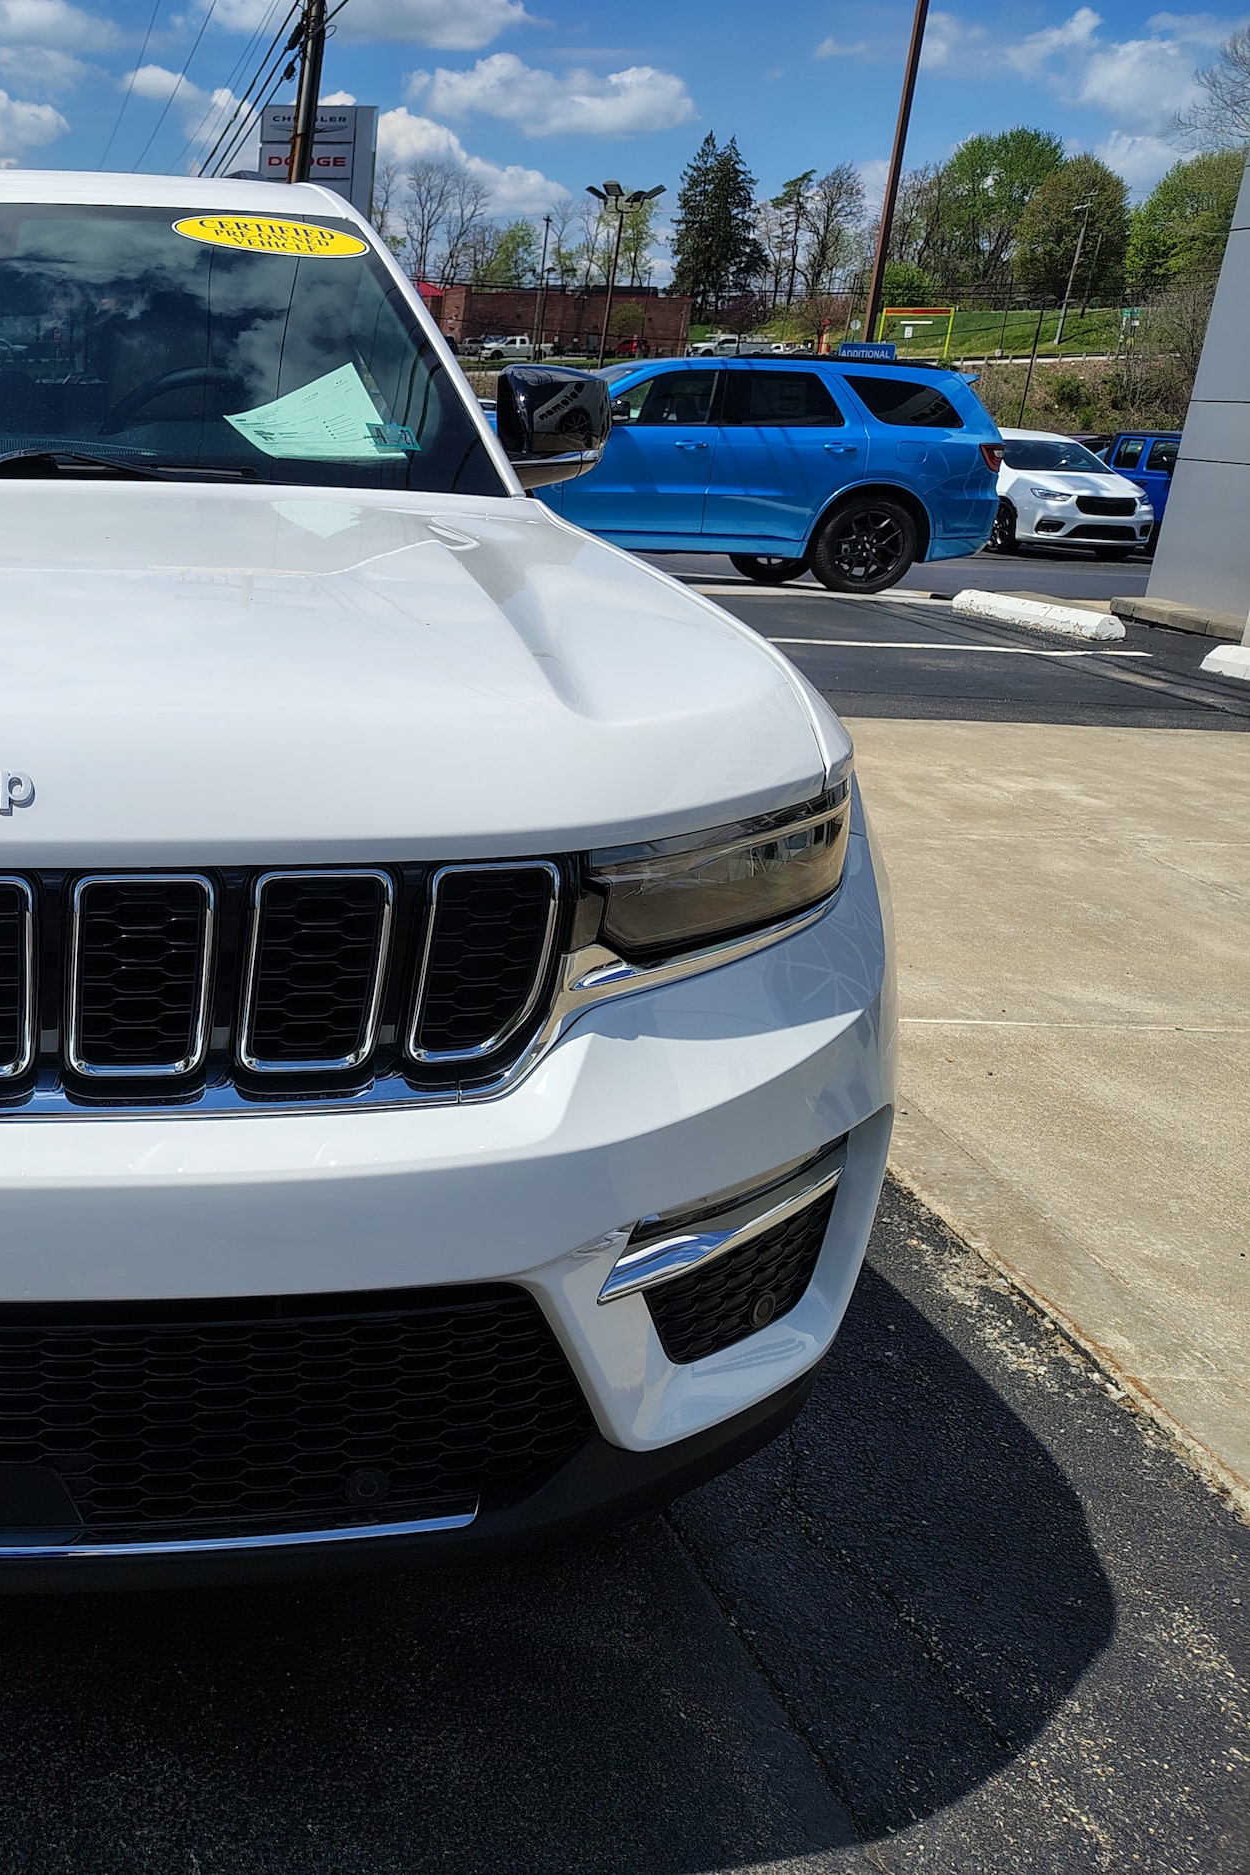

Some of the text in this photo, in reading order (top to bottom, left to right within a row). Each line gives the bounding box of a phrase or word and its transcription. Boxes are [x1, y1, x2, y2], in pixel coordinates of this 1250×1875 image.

[272, 115, 347, 123] CHLER
[268, 156, 347, 168] DGE
[198, 219, 335, 241] CERTIFIED
[213, 229, 330, 247] PRE-OWNED
[233, 237, 320, 253] VEHICLE
[840, 349, 891, 360] ADDITIONAL
